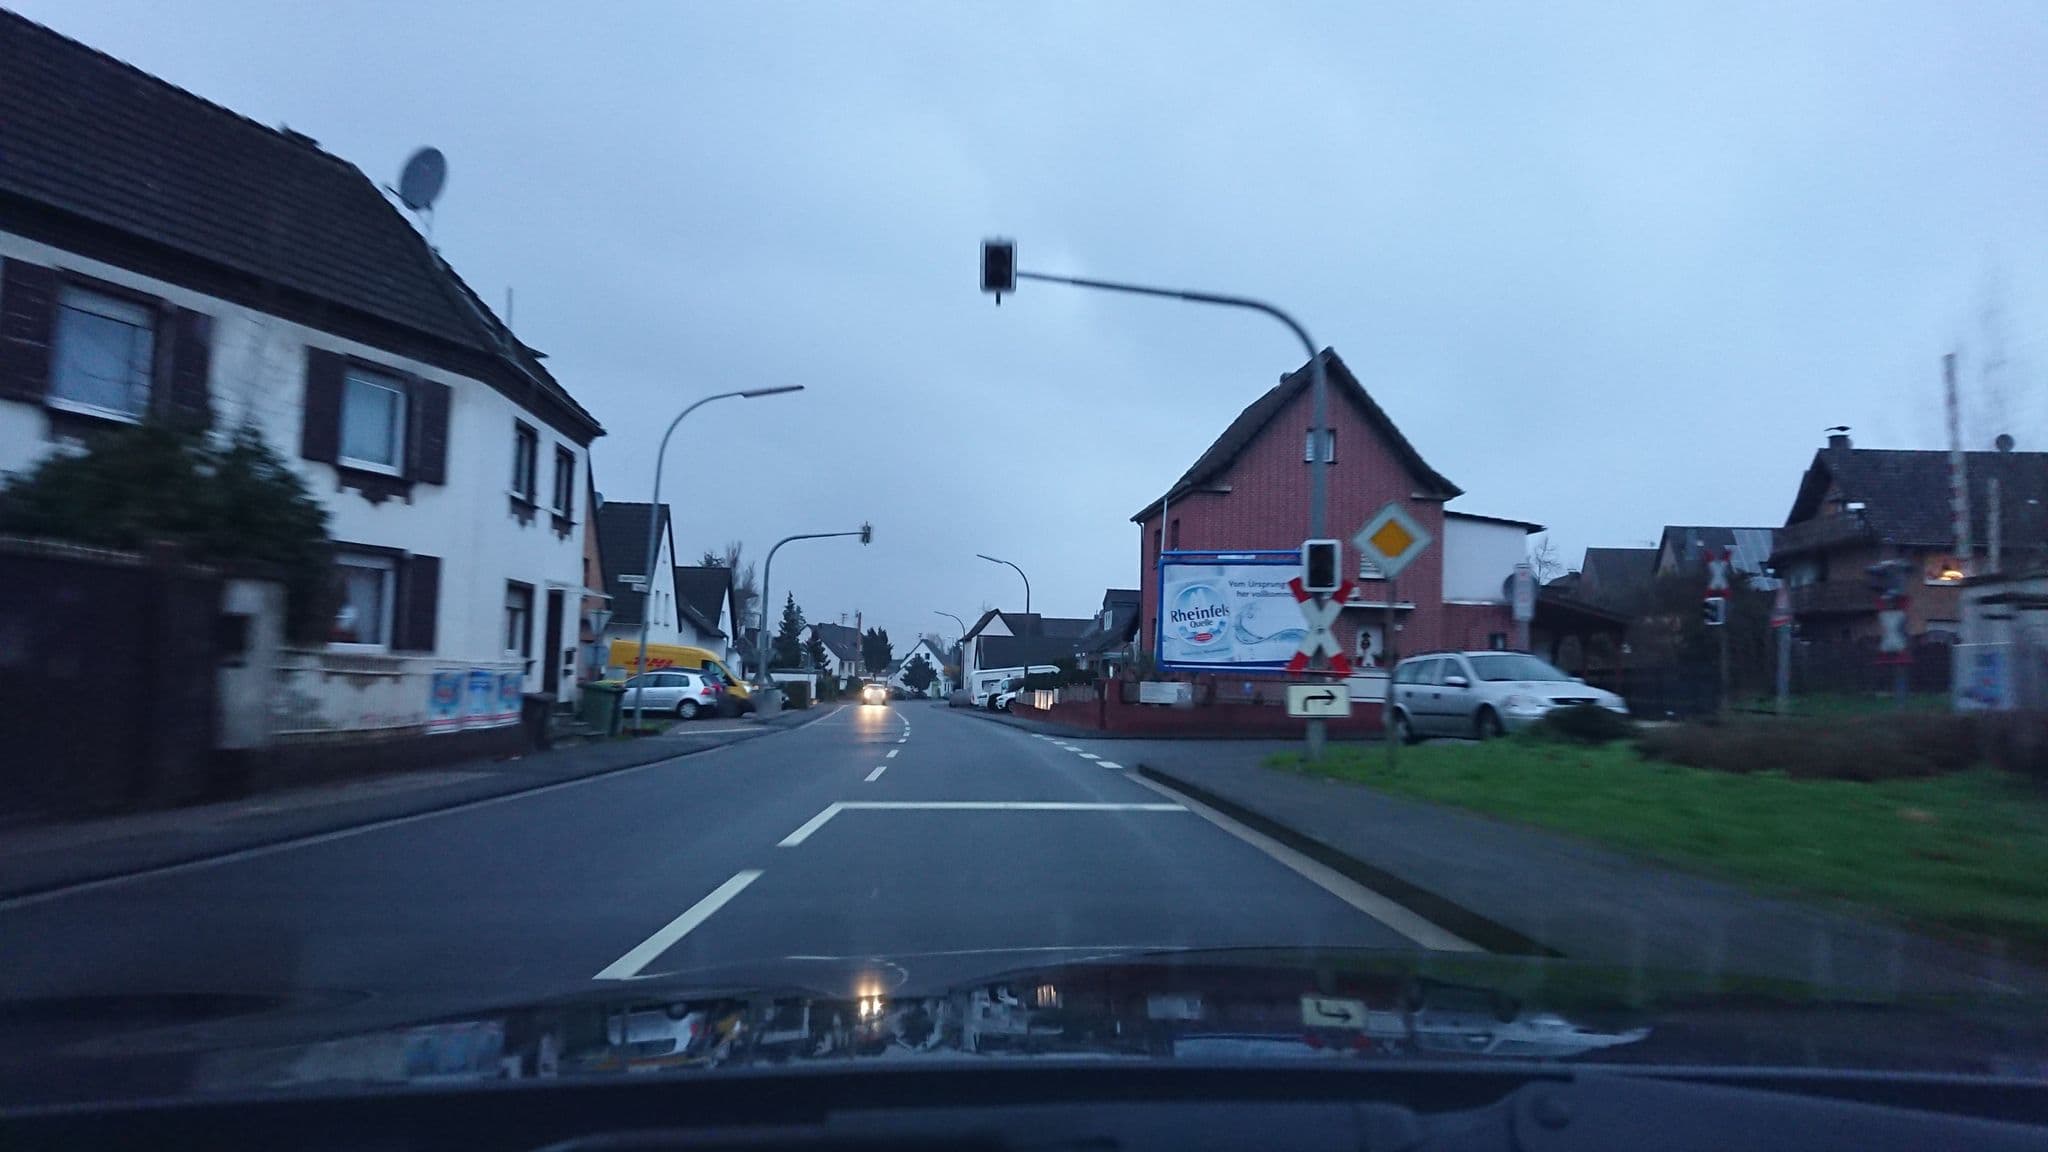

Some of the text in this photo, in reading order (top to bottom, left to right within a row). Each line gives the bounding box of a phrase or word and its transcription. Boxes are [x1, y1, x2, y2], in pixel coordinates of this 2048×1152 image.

[1228, 580, 1286, 590] Vom Ursprung
[1170, 603, 1230, 623] Rheinfels
[1190, 619, 1213, 628] Quelle
